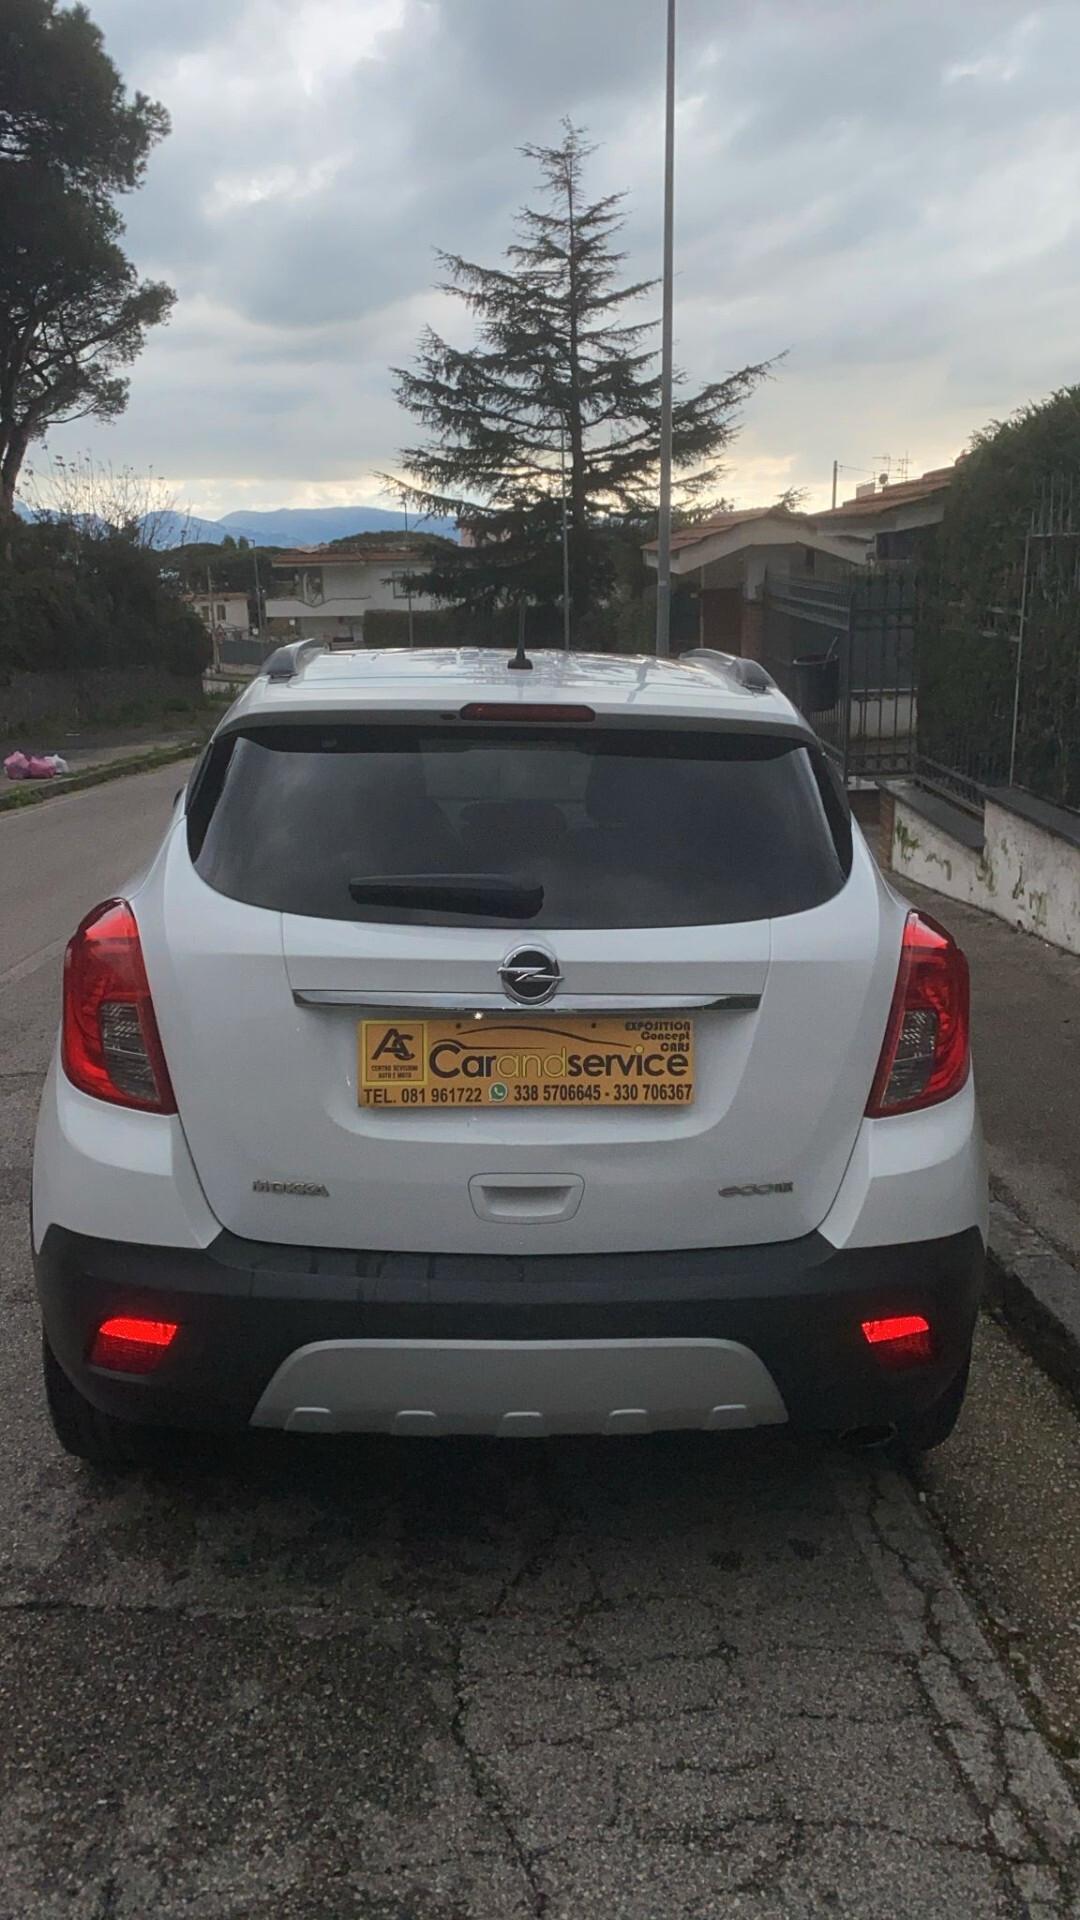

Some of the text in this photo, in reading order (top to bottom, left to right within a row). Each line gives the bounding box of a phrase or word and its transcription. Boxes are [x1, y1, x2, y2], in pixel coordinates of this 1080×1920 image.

[625, 1021, 691, 1031] EXPOSITION
[641, 1031, 690, 1040] Concept
[660, 1042, 690, 1052] CARS
[363, 1087, 482, 1104] TEL. 081 961722
[514, 1085, 538, 1101] 338
[543, 1084, 601, 1101] 5706645
[613, 1084, 638, 1101] 330
[642, 1083, 692, 1100] 706367
